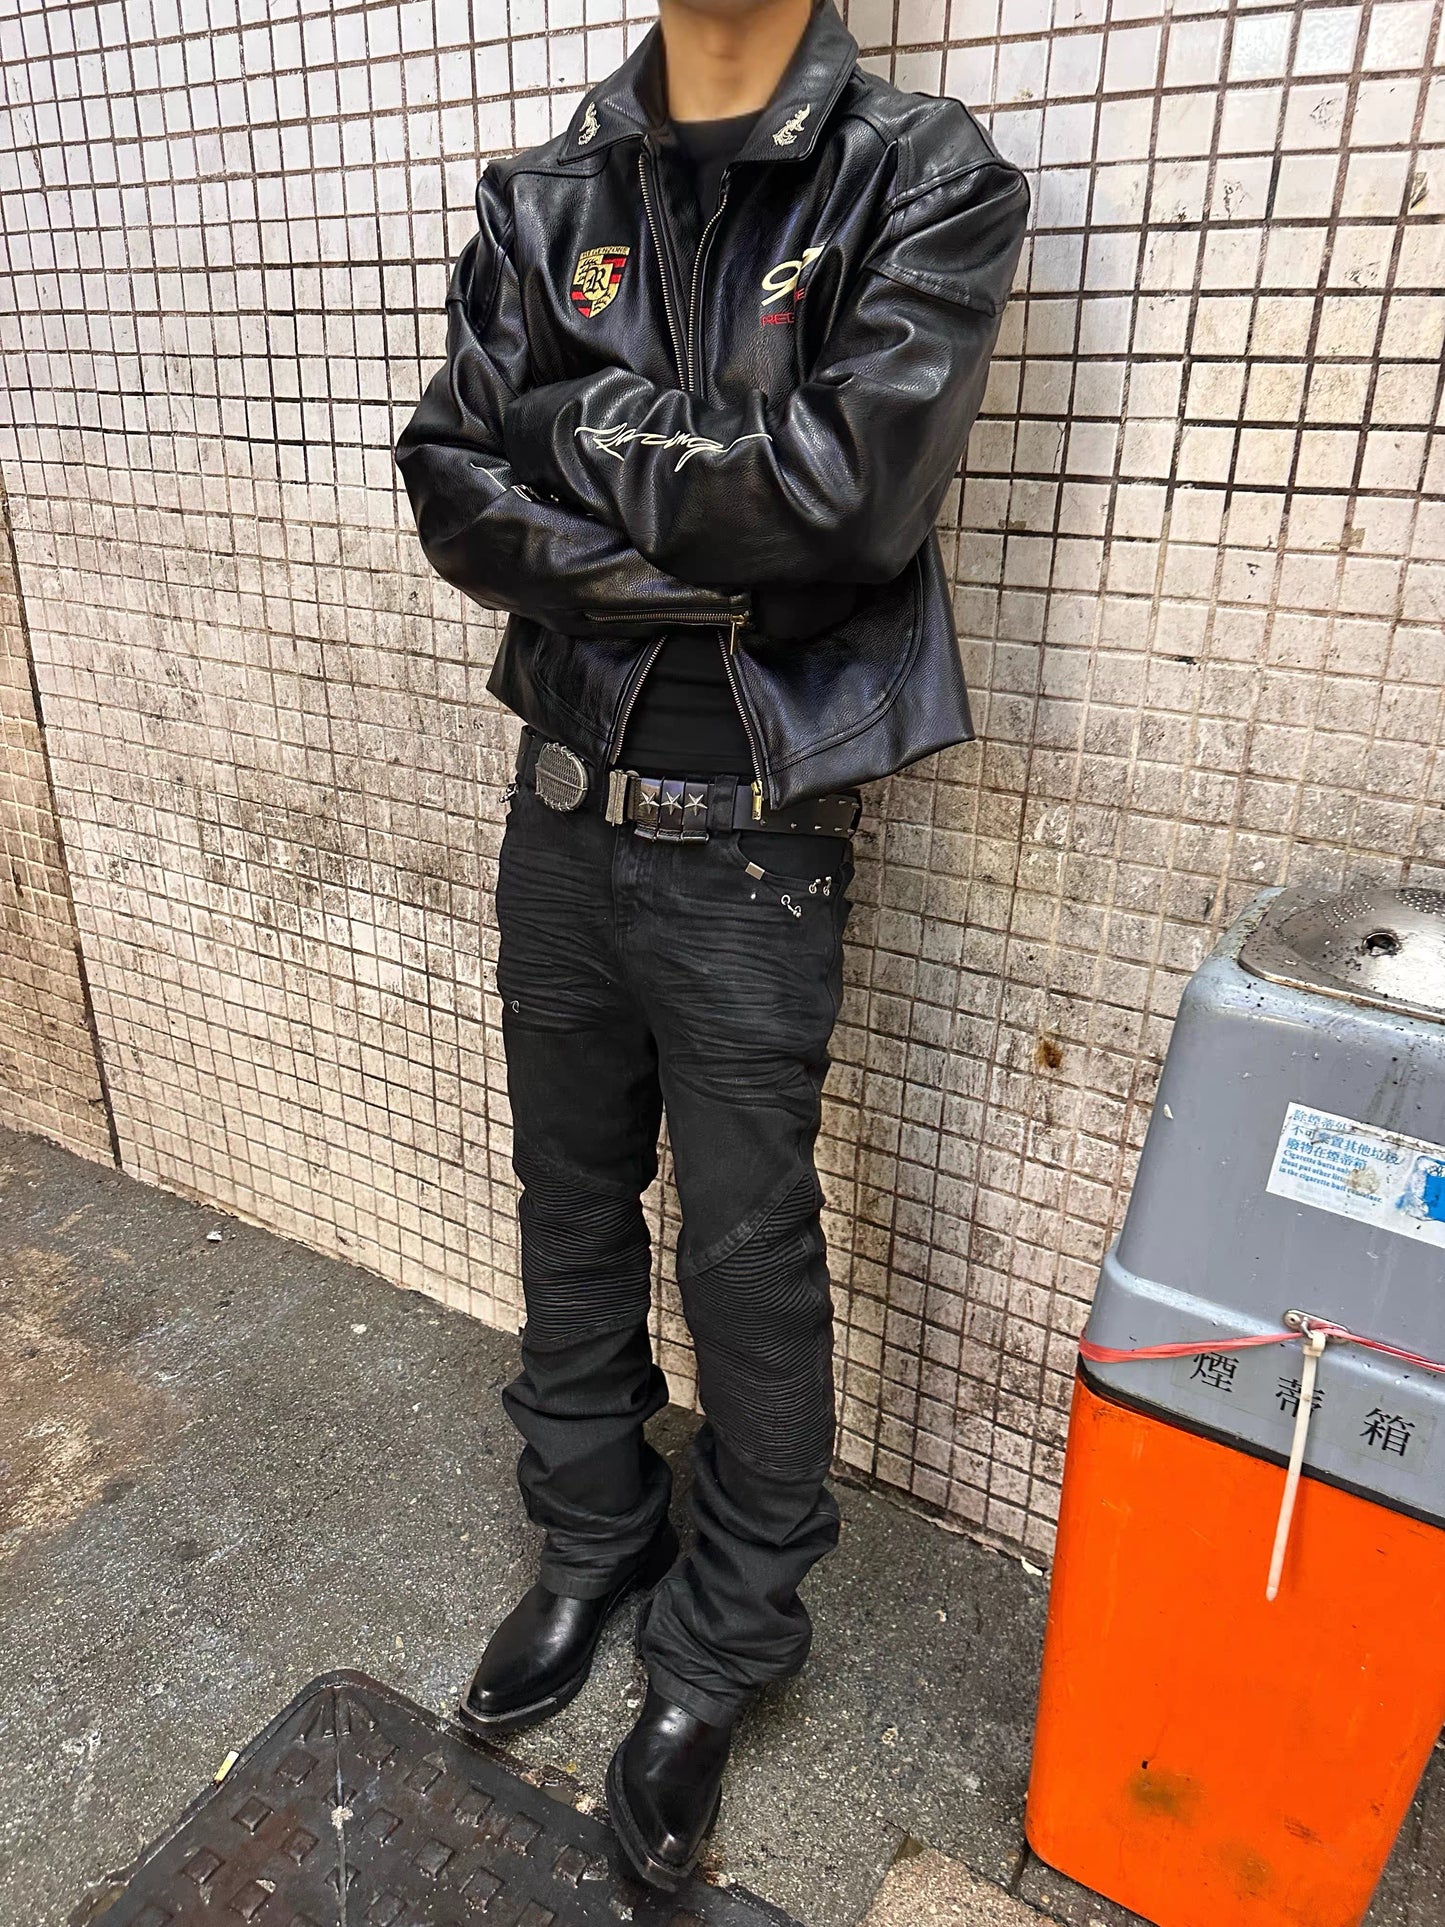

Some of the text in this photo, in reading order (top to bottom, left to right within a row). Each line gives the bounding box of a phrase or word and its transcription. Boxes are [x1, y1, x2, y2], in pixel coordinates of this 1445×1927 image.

[1283, 1149, 1316, 1165] Cigarette
[1299, 1161, 1312, 1173] put
[1312, 1165, 1331, 1178] other
[1299, 1171, 1330, 1187] cigarette
